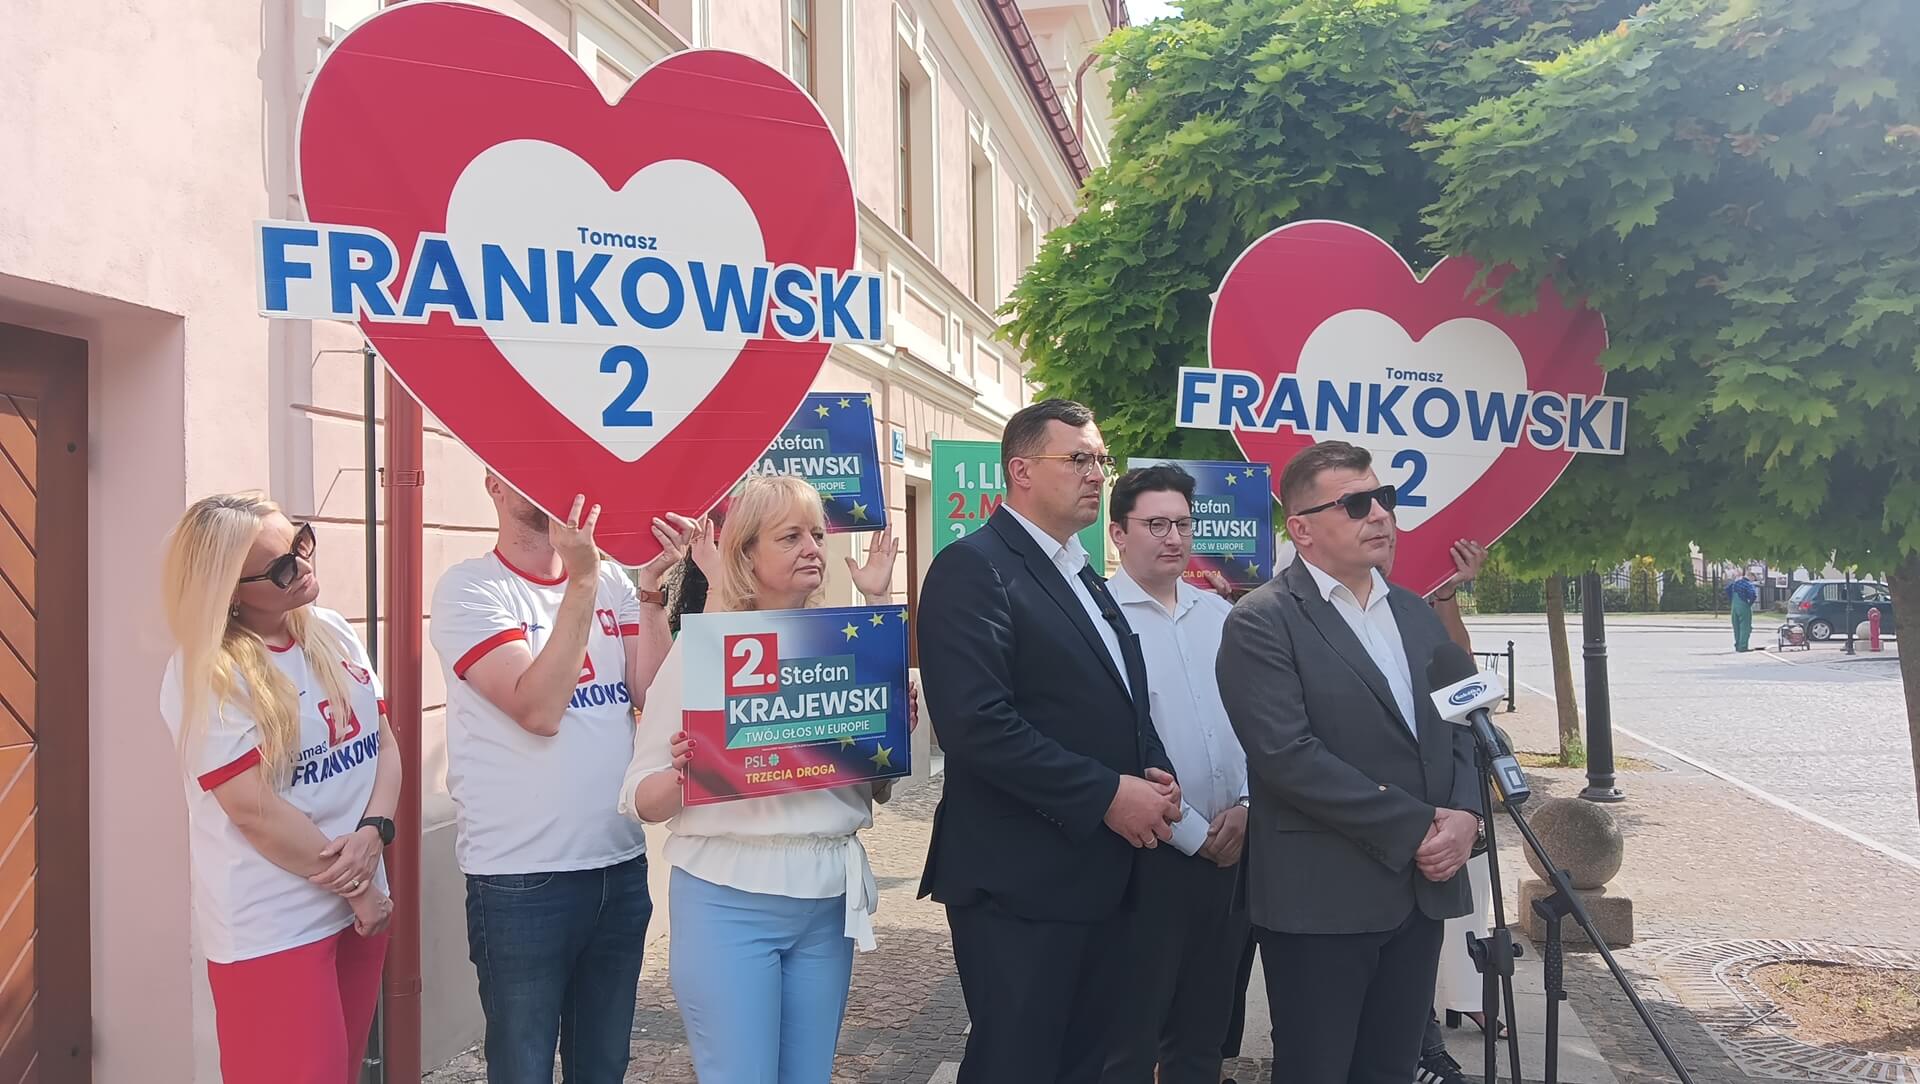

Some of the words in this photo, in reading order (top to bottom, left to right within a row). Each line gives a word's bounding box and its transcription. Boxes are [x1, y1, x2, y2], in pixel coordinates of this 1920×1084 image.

[577, 227, 658, 251] Tomasz
[260, 226, 883, 341] FRANKOWSKI
[599, 345, 654, 428] 2
[1385, 367, 1444, 383] Tomasz
[1181, 371, 1626, 451] FRANKOWSKI
[1390, 449, 1427, 507] 2
[1192, 520, 1257, 537] JEWSKI
[1216, 543, 1244, 551] EUROPIE
[731, 637, 777, 688] 2.
[780, 662, 849, 686] Stefan
[729, 686, 888, 725] KRAJEWSKI
[744, 727, 780, 743] TWÓJ
[782, 726, 812, 740] GŁOS
[815, 725, 826, 736] W
[828, 719, 870, 735] EUROPIE
[744, 755, 767, 769] PSL
[745, 770, 793, 784] TRZECIA
[796, 763, 836, 778] DROGA
